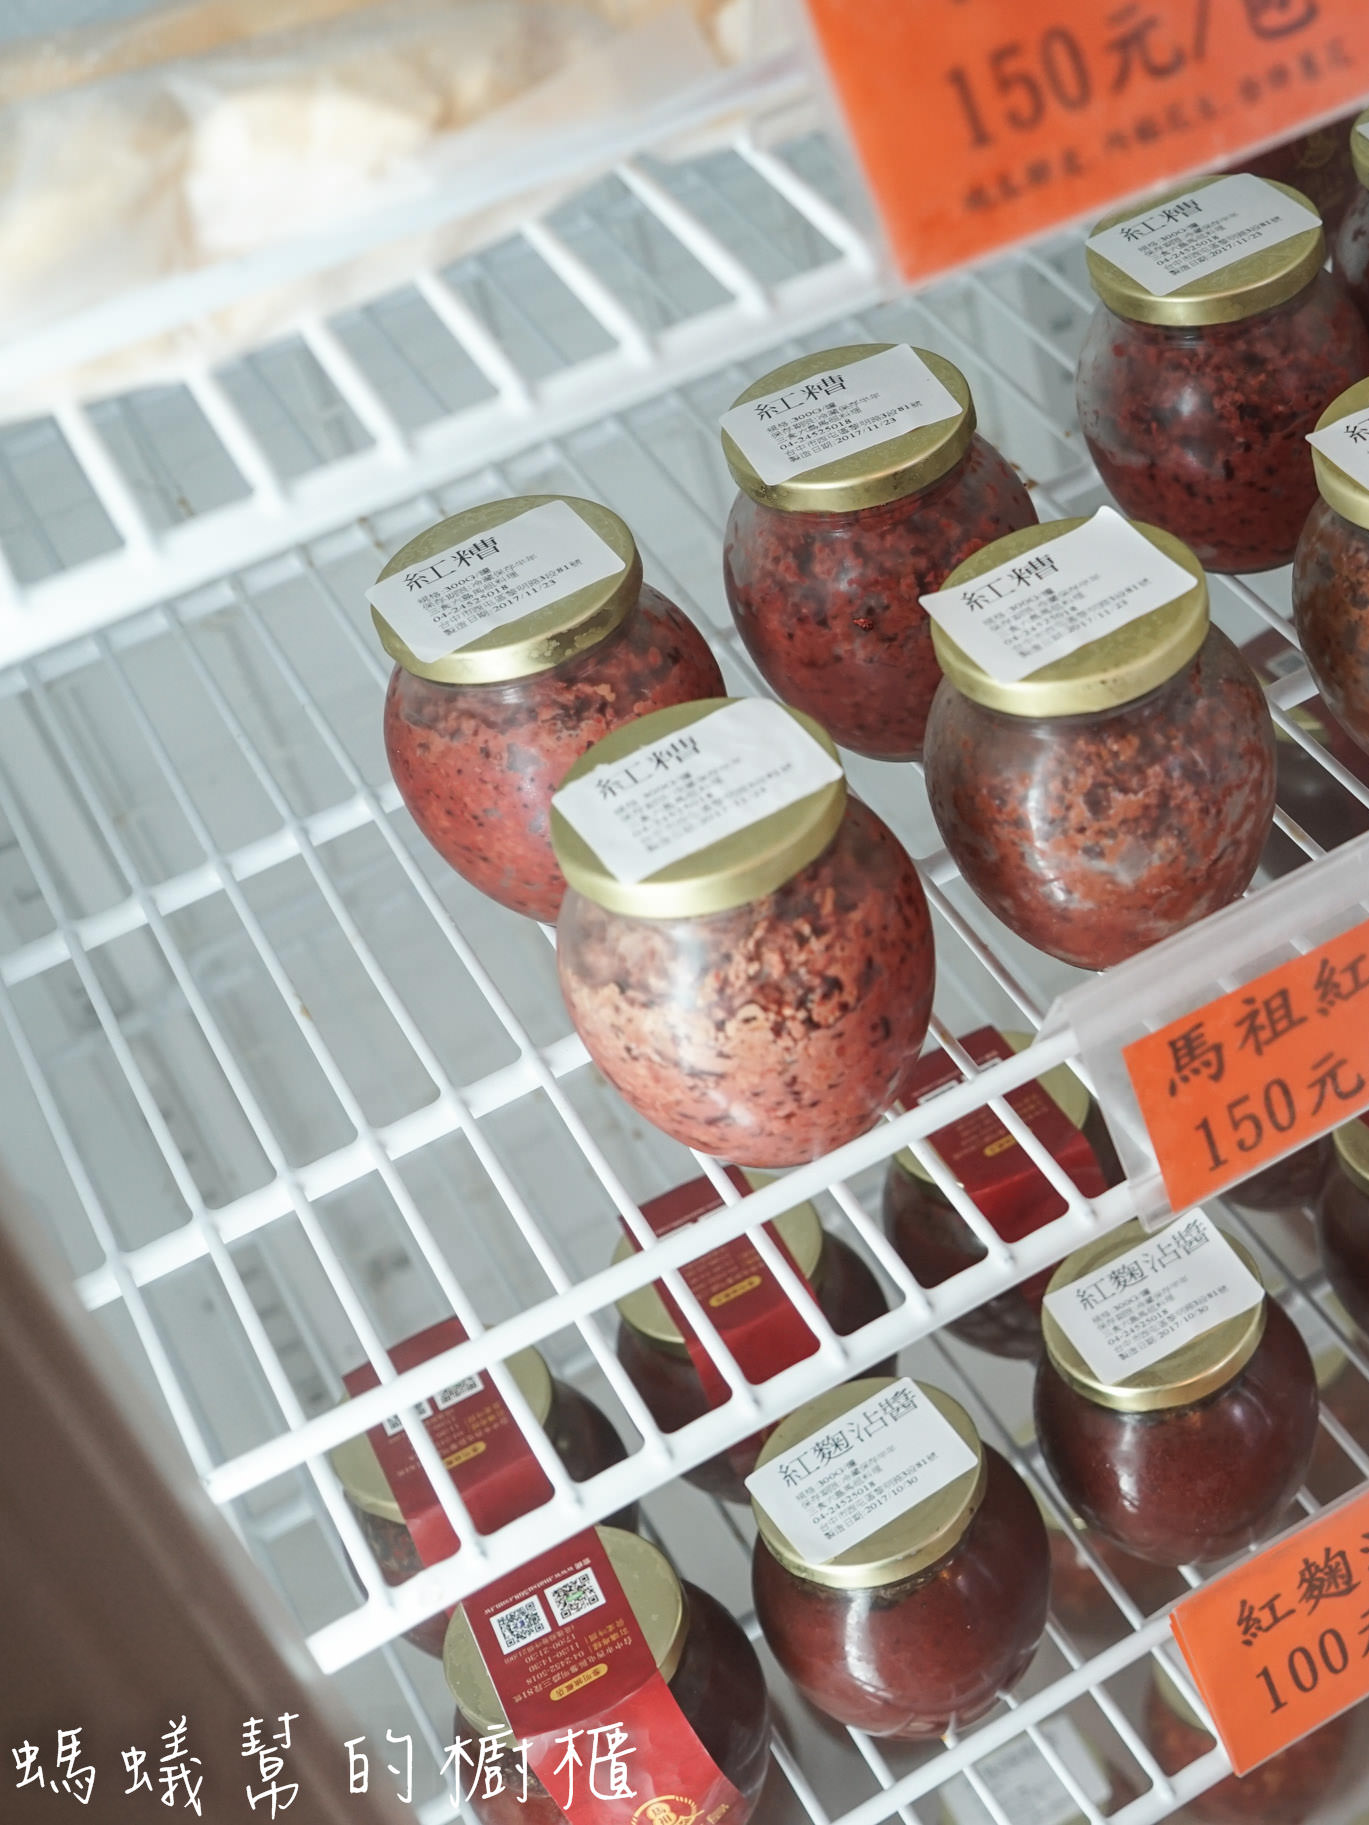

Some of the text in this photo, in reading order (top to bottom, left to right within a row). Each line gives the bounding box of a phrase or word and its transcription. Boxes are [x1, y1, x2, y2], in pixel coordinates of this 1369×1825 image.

[1115, 198, 1206, 241] 紅糟
[751, 372, 850, 421] 紅糟
[778, 417, 852, 450] 04-24525018
[398, 534, 505, 592] 紅糟
[956, 553, 1064, 613] 紅糟
[431, 583, 508, 623] 04-24525018
[588, 734, 708, 800] 紅糟
[1072, 1217, 1215, 1313] 紅麴沾醬
[773, 1384, 923, 1489] 紅麴沾醬
[811, 1480, 876, 1525] 04-24525018
